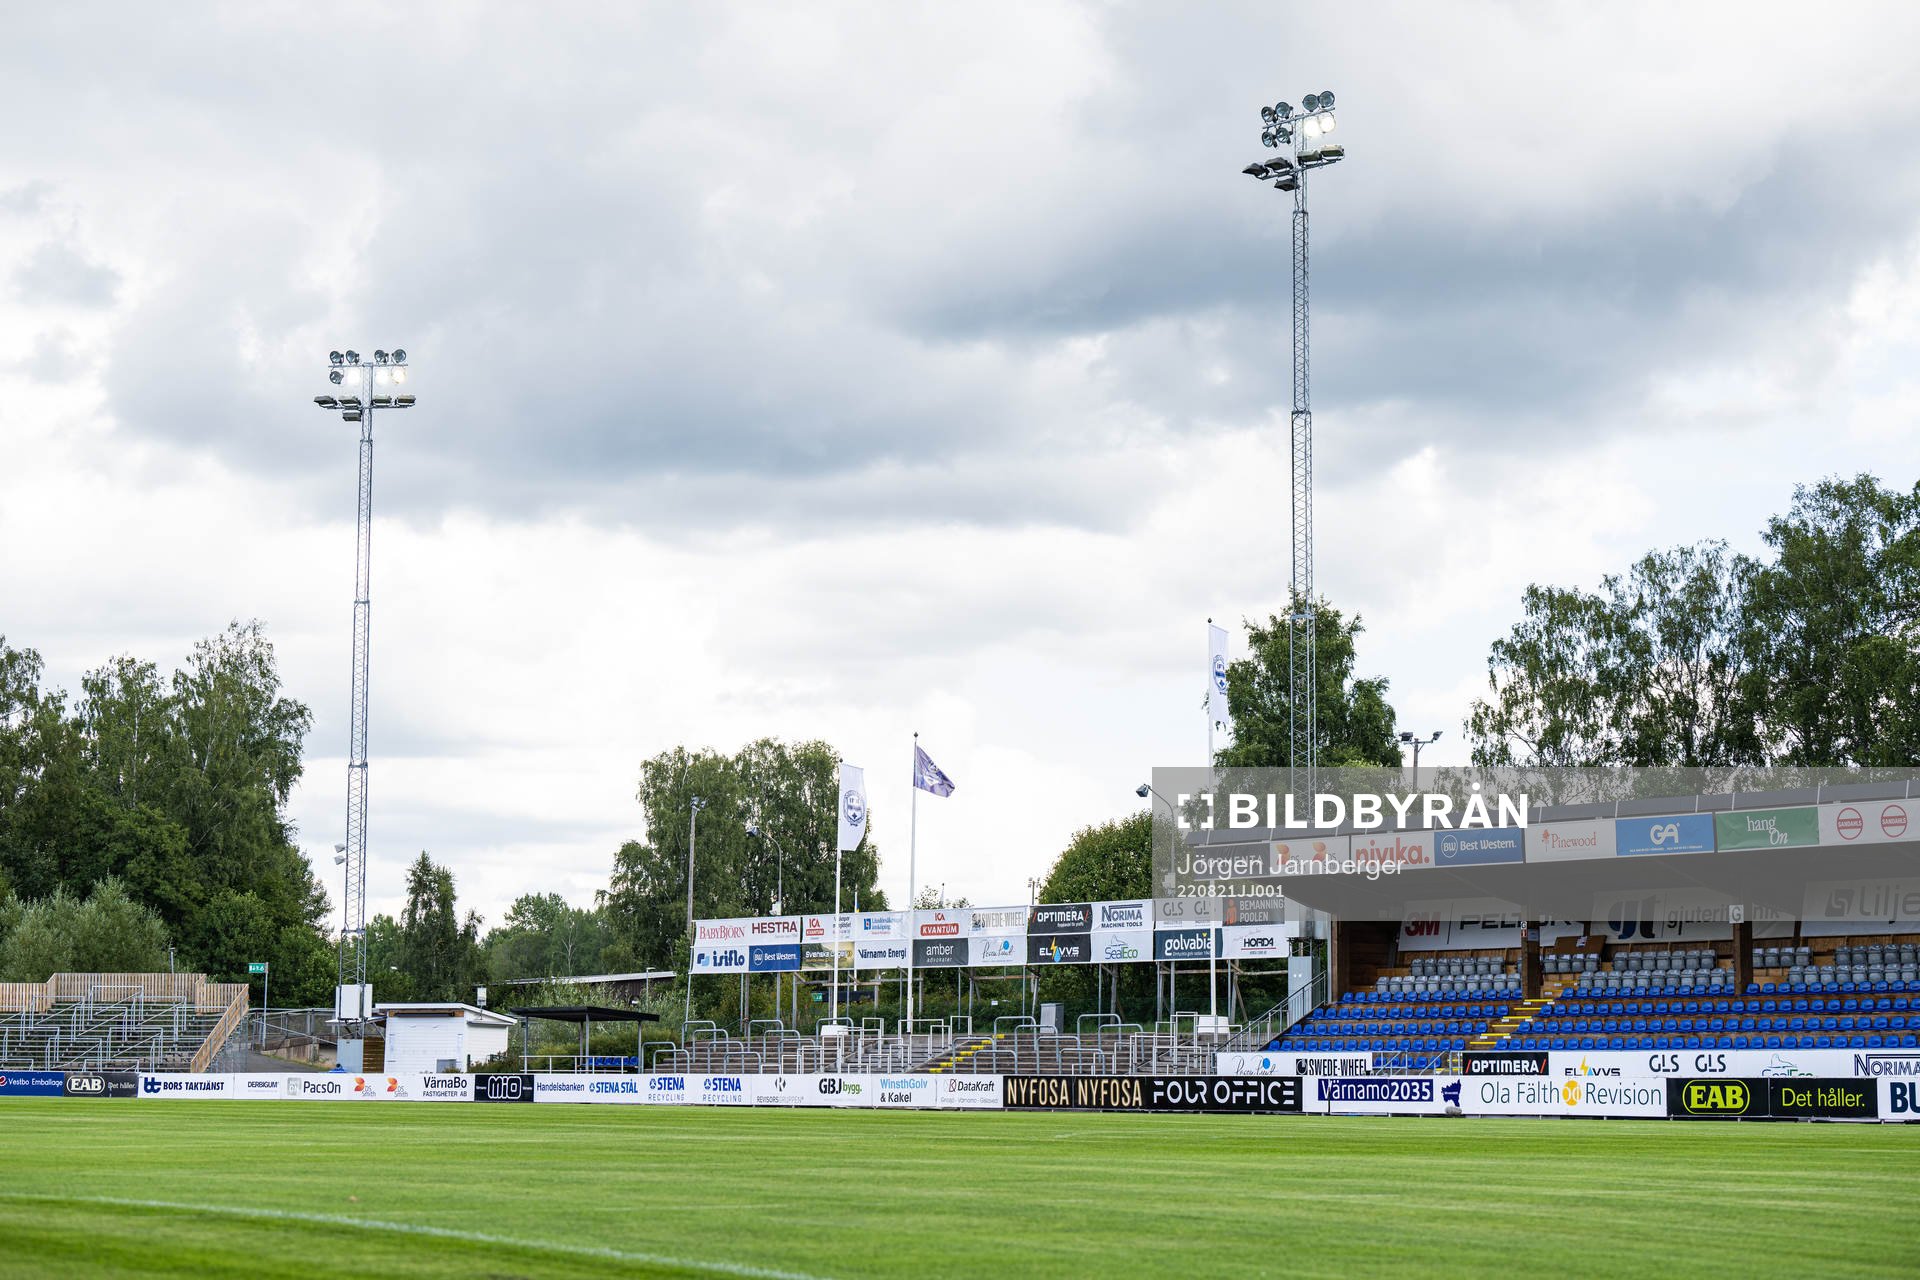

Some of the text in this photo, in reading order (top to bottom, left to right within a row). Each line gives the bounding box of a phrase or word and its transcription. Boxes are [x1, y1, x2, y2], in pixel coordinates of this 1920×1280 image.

[1747, 816, 1776, 833] hang
[1460, 841, 1478, 851] Best
[1551, 832, 1597, 849] Pinewood
[935, 912, 946, 921] ICA
[1101, 905, 1143, 922] NORIMA
[1240, 912, 1269, 923] POOLEN
[752, 921, 797, 934] HESTRA
[809, 918, 820, 928] ICA
[922, 924, 958, 934] KVANTUM
[1126, 921, 1143, 929] TOOLS
[858, 947, 907, 960] Värnamo Energi
[926, 944, 954, 956] amber
[1039, 947, 1052, 956] EL
[1105, 946, 1139, 960] SeaEco
[713, 949, 745, 967] isiflo
[1471, 1060, 1540, 1073] OPTIMERA
[1649, 1054, 1727, 1073] GLS GLS
[8, 1078, 63, 1088] Vestbo Emballage
[70, 1079, 102, 1091] EAB
[163, 1080, 225, 1091] BORS TAKTJÄNST
[303, 1081, 341, 1094] PacsOn
[423, 1076, 468, 1089] VärnaBo
[536, 1082, 585, 1092] Handelsbanken
[596, 1079, 639, 1094] STENA STÅL
[657, 1077, 685, 1090] STENA
[712, 1078, 742, 1091] STENA
[957, 1080, 995, 1092] DataKraft
[648, 1093, 685, 1101] RECYCLING
[702, 1094, 742, 1103] RECYCLING
[880, 1092, 912, 1103] & Kakel
[1007, 1078, 1143, 1107] NYFOSA NYFOSA
[1153, 1080, 1295, 1105] FOUR OFFICE
[1481, 1081, 1661, 1106] Ola Fälth Revision
[1690, 1085, 1744, 1109] EAB
[1782, 1087, 1865, 1107] Det håller.
